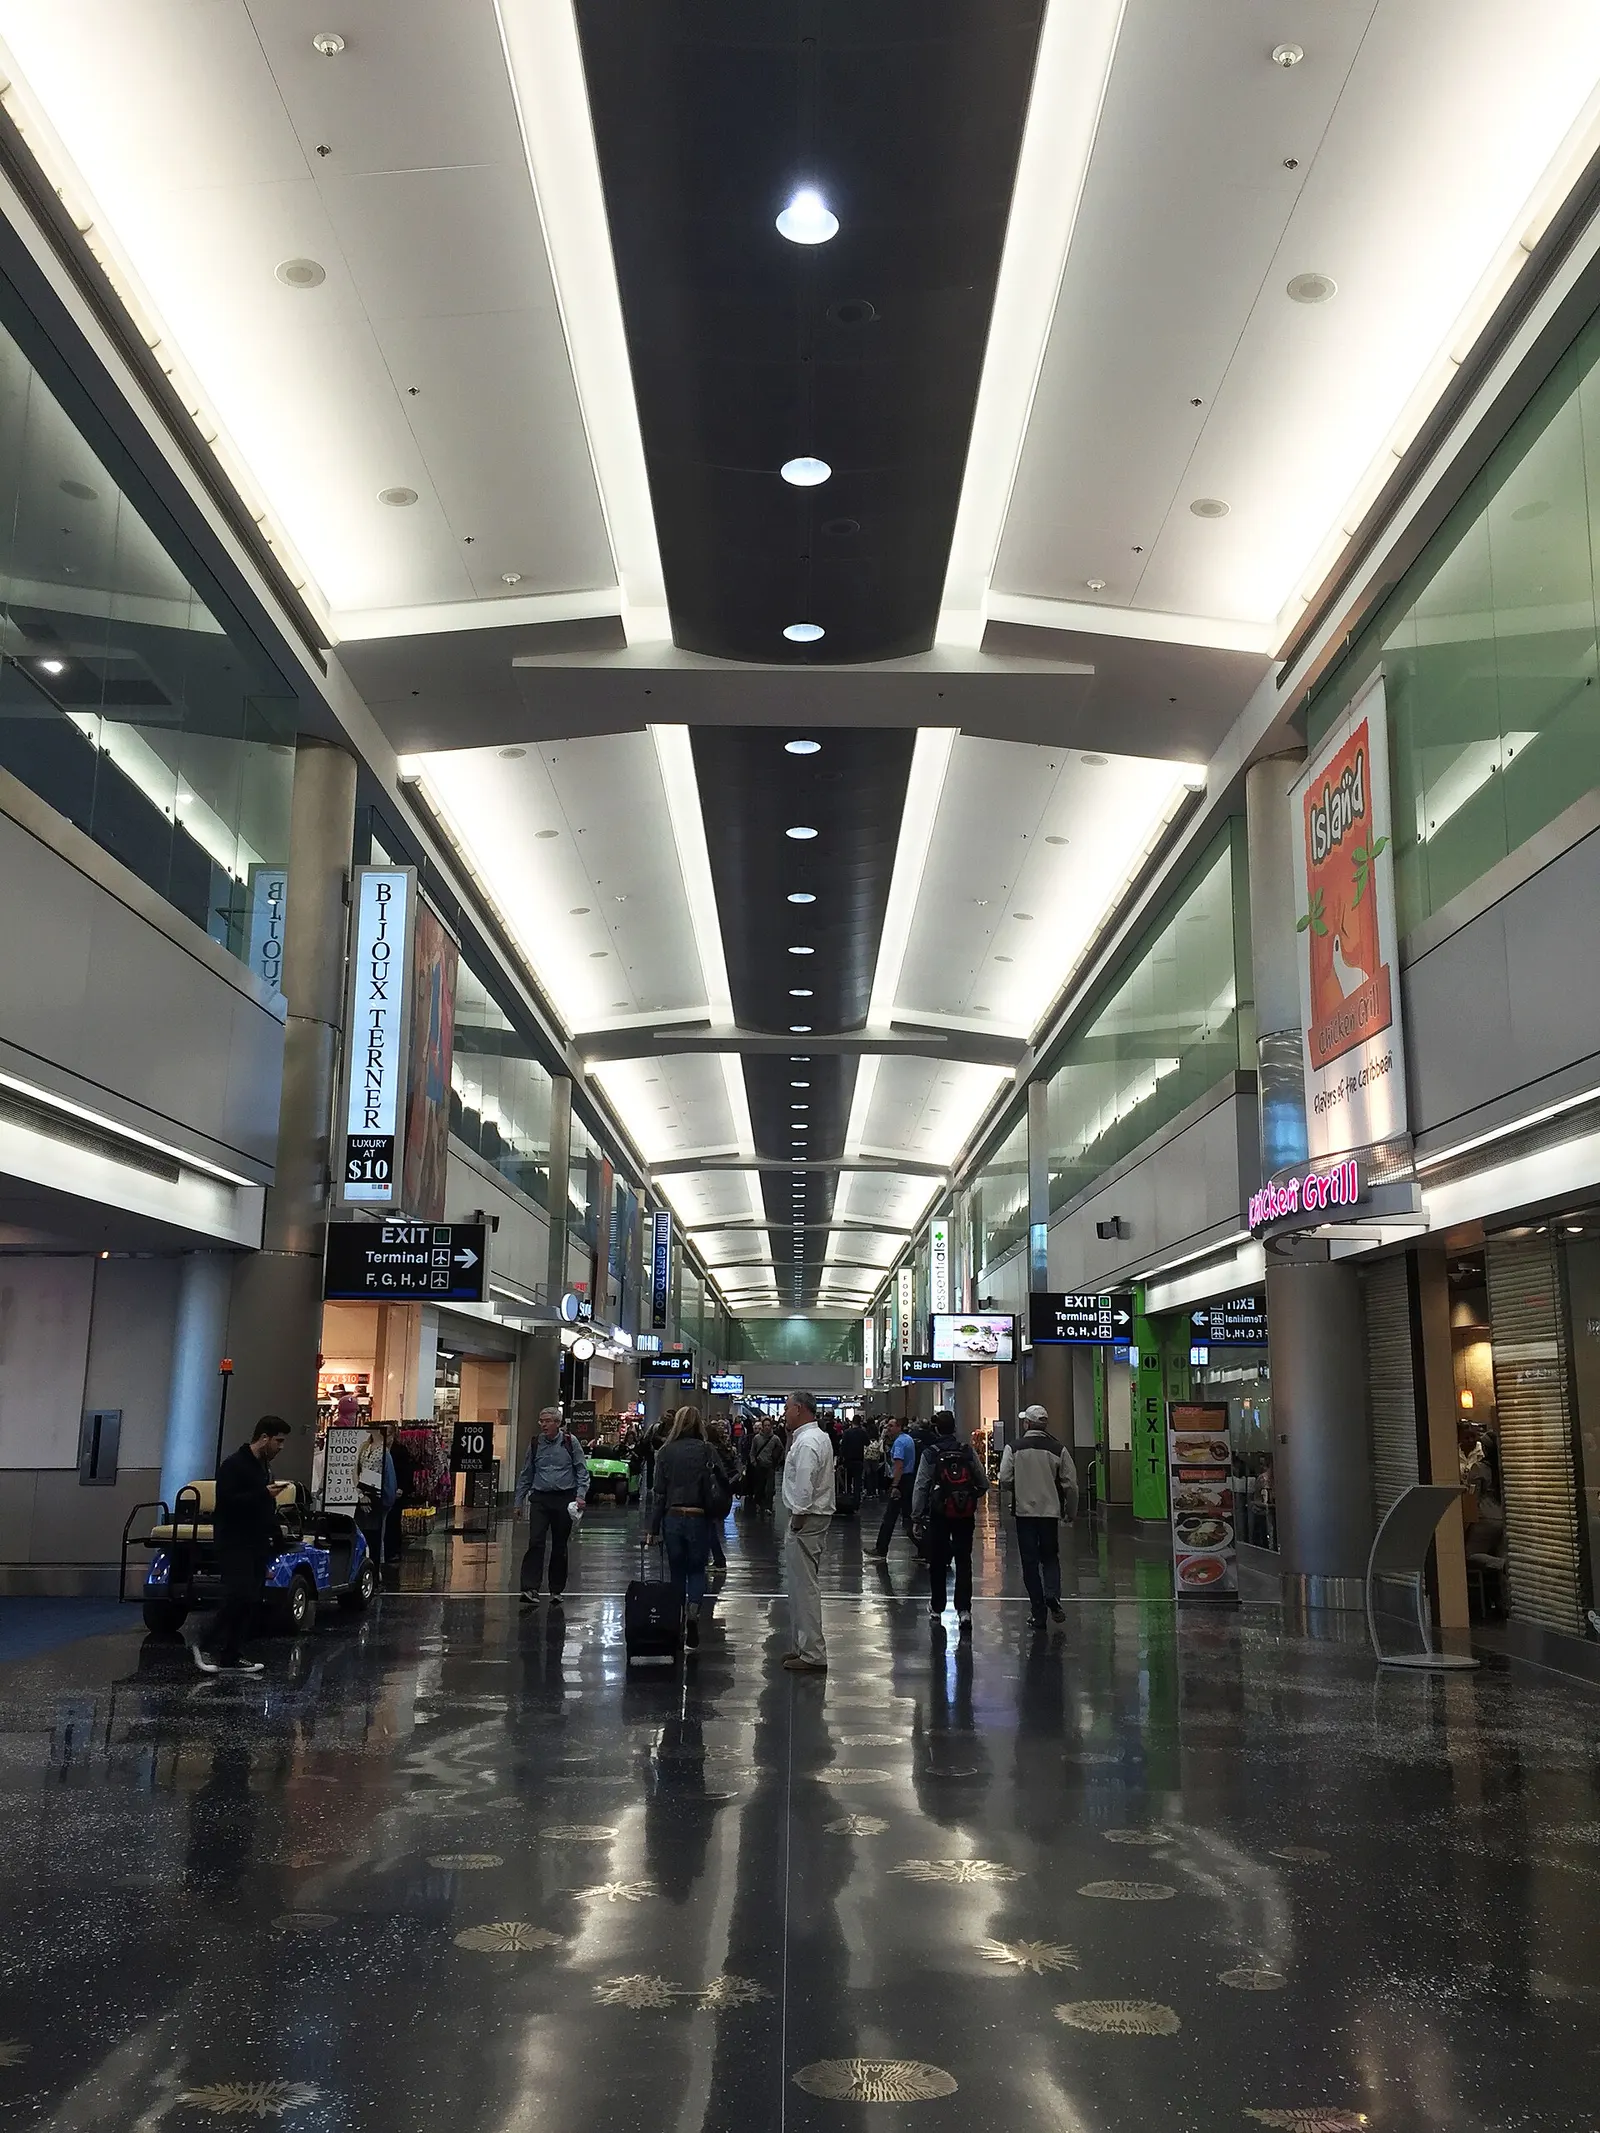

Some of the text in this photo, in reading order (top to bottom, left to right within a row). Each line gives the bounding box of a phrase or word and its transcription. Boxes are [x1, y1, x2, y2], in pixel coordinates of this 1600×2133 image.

[1311, 748, 1364, 865] Island
[363, 883, 391, 1128] BIJOUX TERNER
[1319, 982, 1380, 1055] Chicken Grill
[352, 1139, 387, 1148] LUXURY
[363, 1150, 375, 1158] AT
[348, 1159, 388, 1180] $10
[1302, 1160, 1358, 1211] Grill
[382, 1227, 429, 1244] EXIT
[657, 1214, 668, 1244] MIAMI
[366, 1251, 428, 1263] Terminal
[656, 1246, 666, 1275] GIFTS
[366, 1274, 427, 1287] F, G, H, J
[656, 1276, 665, 1290] TO
[934, 1242, 945, 1310] essentials
[655, 1291, 665, 1309] GO
[1065, 1296, 1096, 1308] EXIT
[1055, 1312, 1097, 1321] Terminal
[1057, 1327, 1098, 1336] F, G, H, J
[461, 1435, 484, 1454] $10
[1146, 1397, 1160, 1474] EXIT
[330, 1446, 357, 1454] TODO
